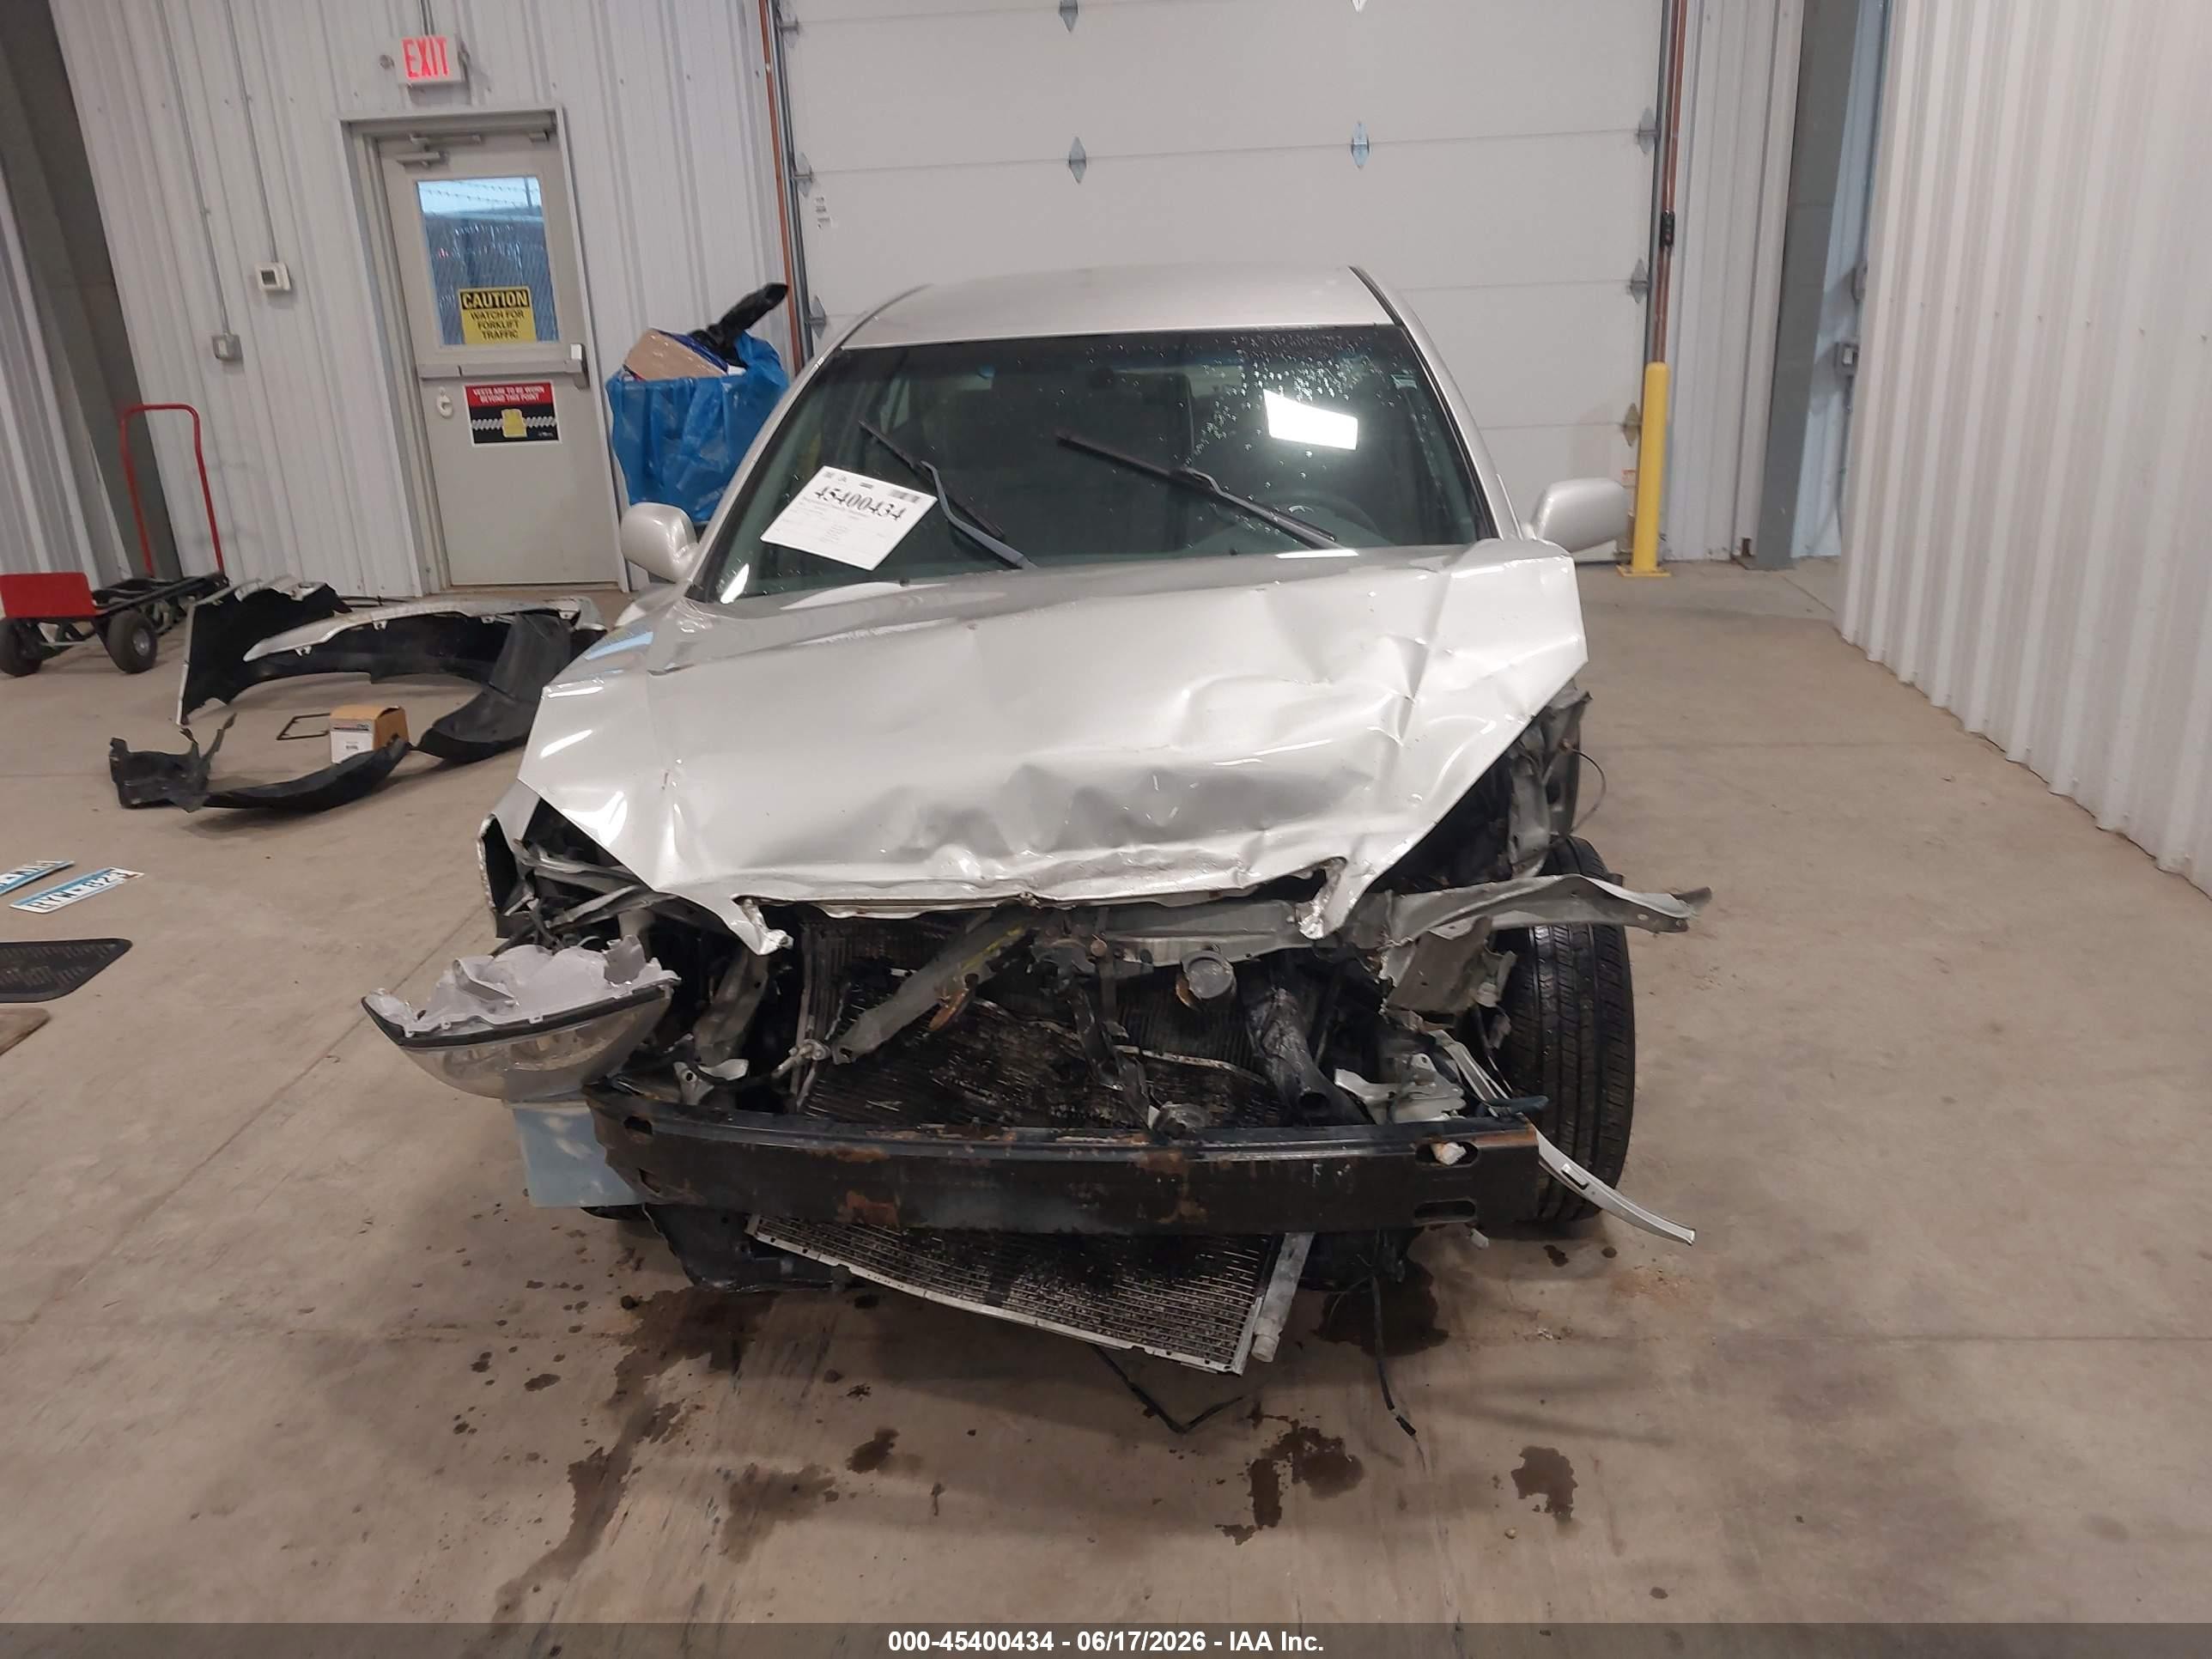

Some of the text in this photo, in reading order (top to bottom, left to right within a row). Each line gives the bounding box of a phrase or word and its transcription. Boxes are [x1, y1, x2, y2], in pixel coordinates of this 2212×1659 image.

[402, 38, 448, 78] EXIT
[462, 290, 528, 309] CAUTION
[470, 309, 525, 320] WATCH FOR
[477, 320, 519, 330] FORKLIFT
[482, 330, 519, 340] TRAFFIC
[815, 485, 907, 521] 45400434
